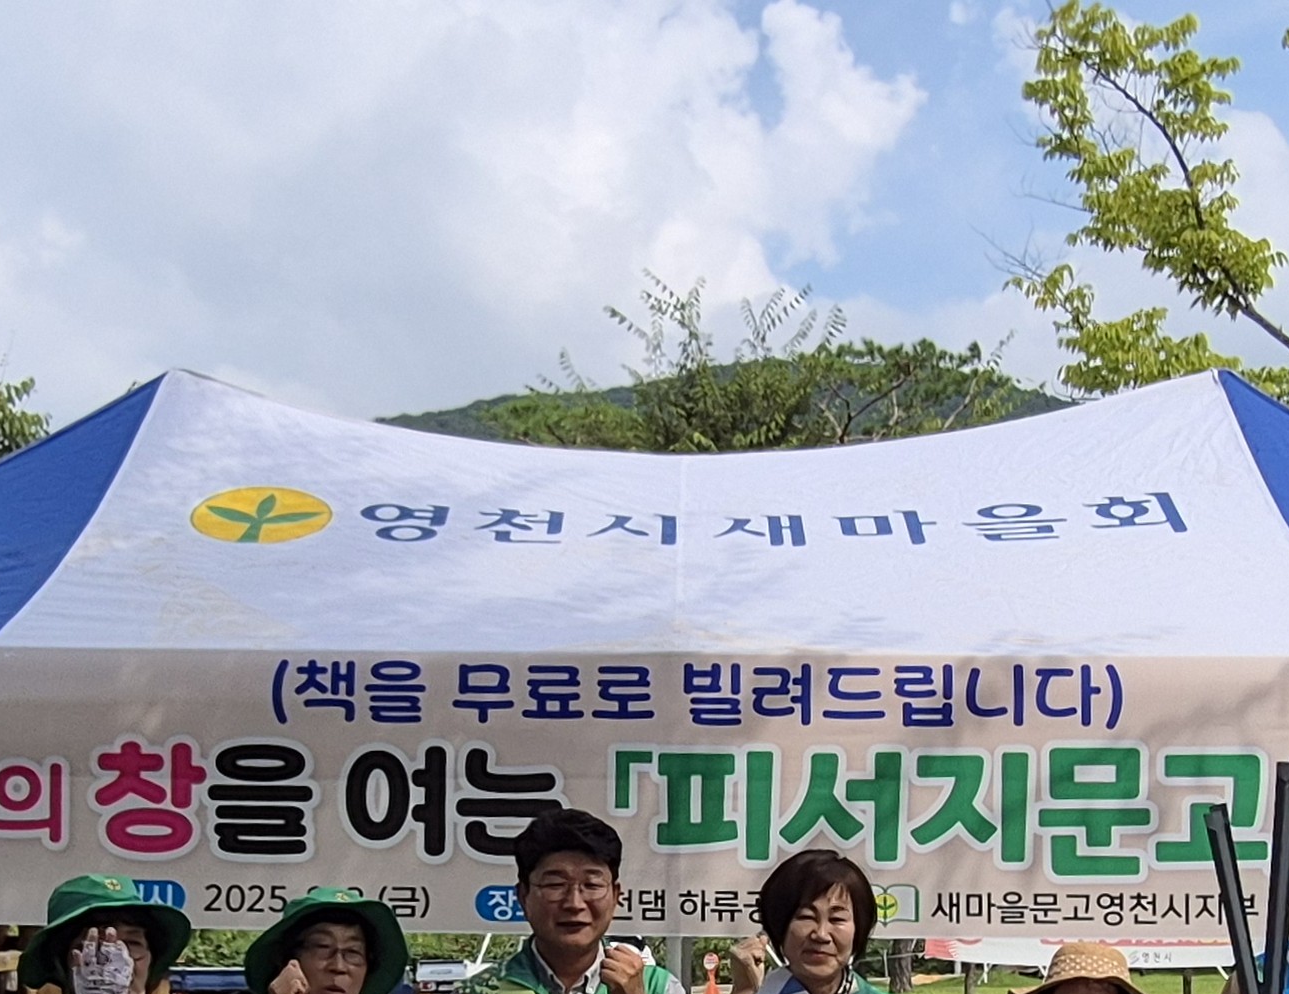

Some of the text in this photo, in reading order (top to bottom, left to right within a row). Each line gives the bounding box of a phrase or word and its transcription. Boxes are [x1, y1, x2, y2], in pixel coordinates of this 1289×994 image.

[359, 492, 1189, 547] 영천시새마을회
[270, 660, 1123, 729] (책을 무료로 빌려드립니다)
[95, 741, 312, 855] 창을
[343, 744, 563, 853] 여는
[139, 882, 173, 906] 시
[487, 889, 524, 920] 장
[679, 889, 761, 923] 하류공
